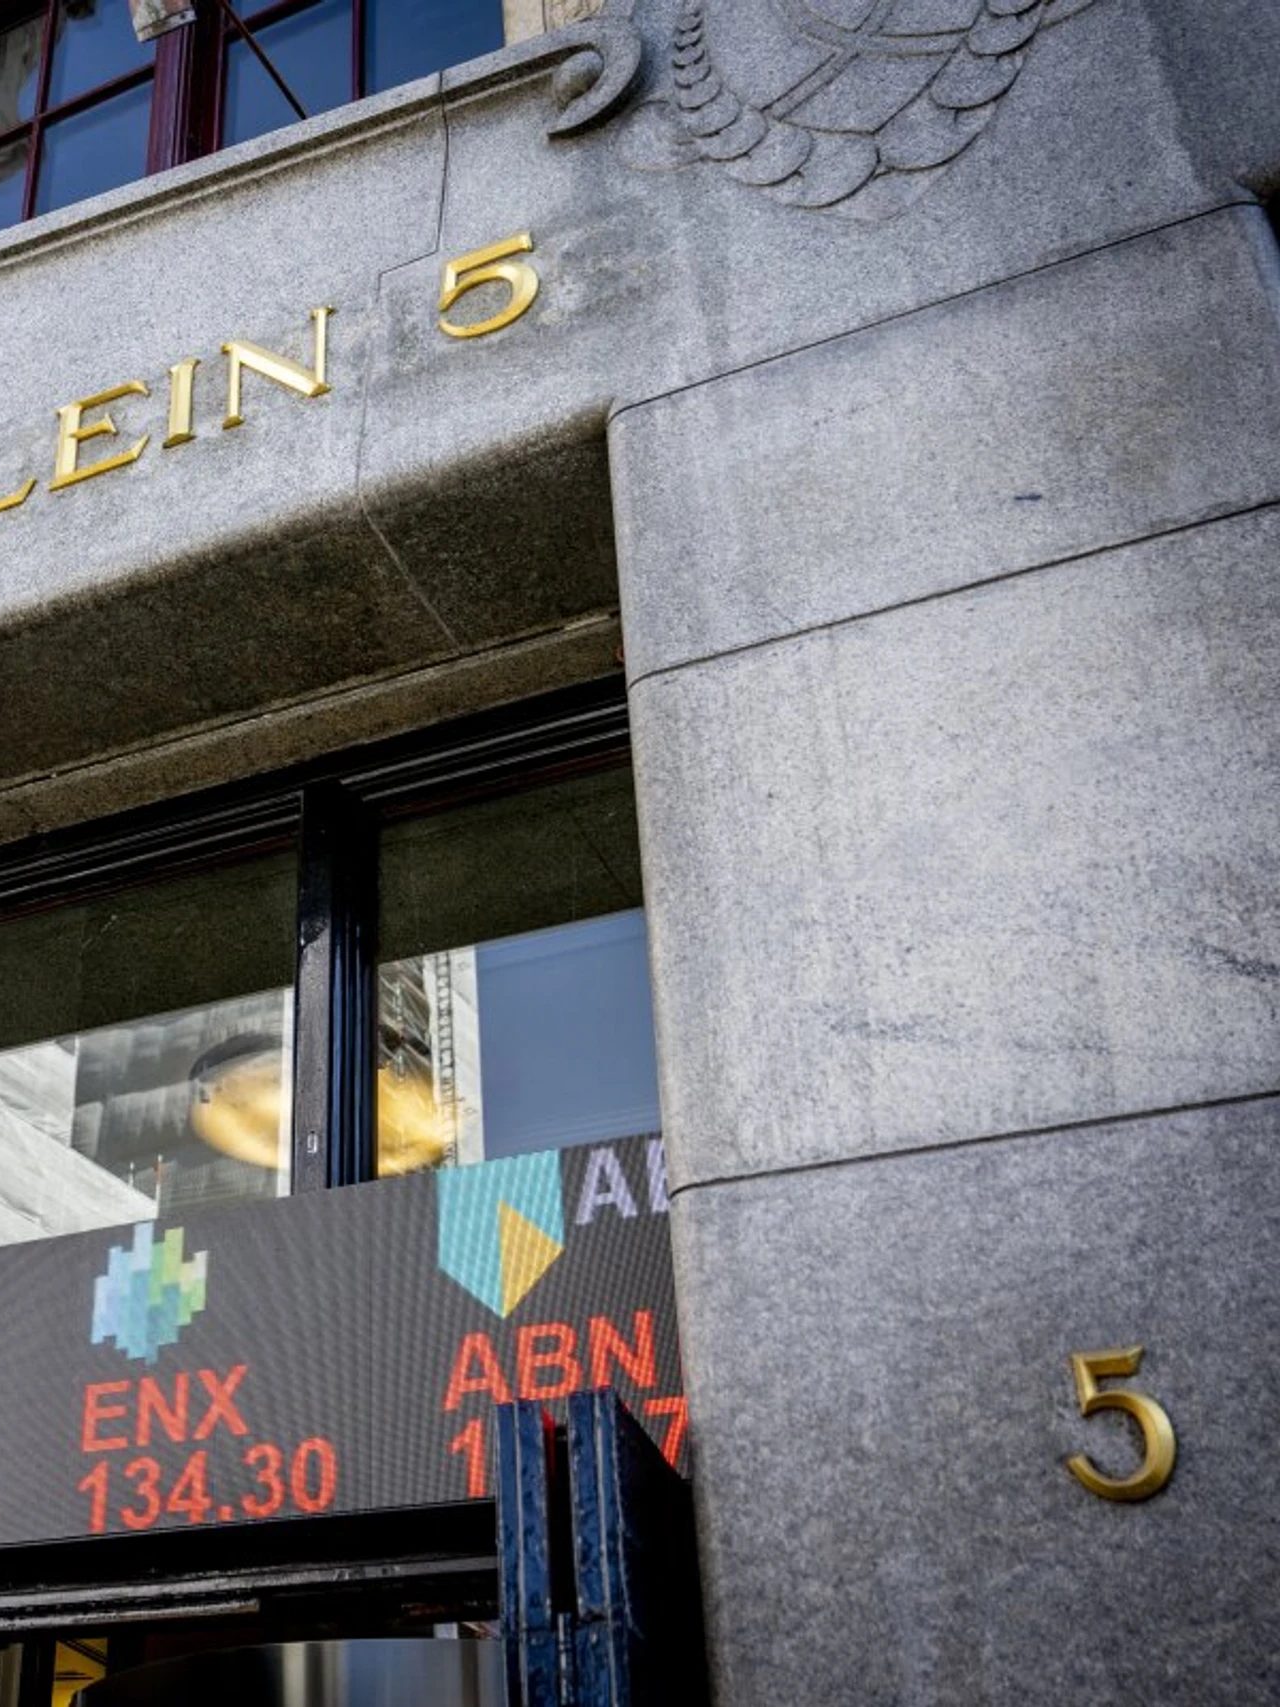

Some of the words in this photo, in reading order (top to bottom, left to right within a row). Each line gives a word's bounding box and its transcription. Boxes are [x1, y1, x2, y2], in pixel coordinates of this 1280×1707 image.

[439, 235, 539, 338] 5
[80, 1364, 249, 1453] ENX
[443, 1310, 657, 1412] ABN
[1066, 1344, 1177, 1502] 5
[77, 1436, 338, 1533] 134.30
